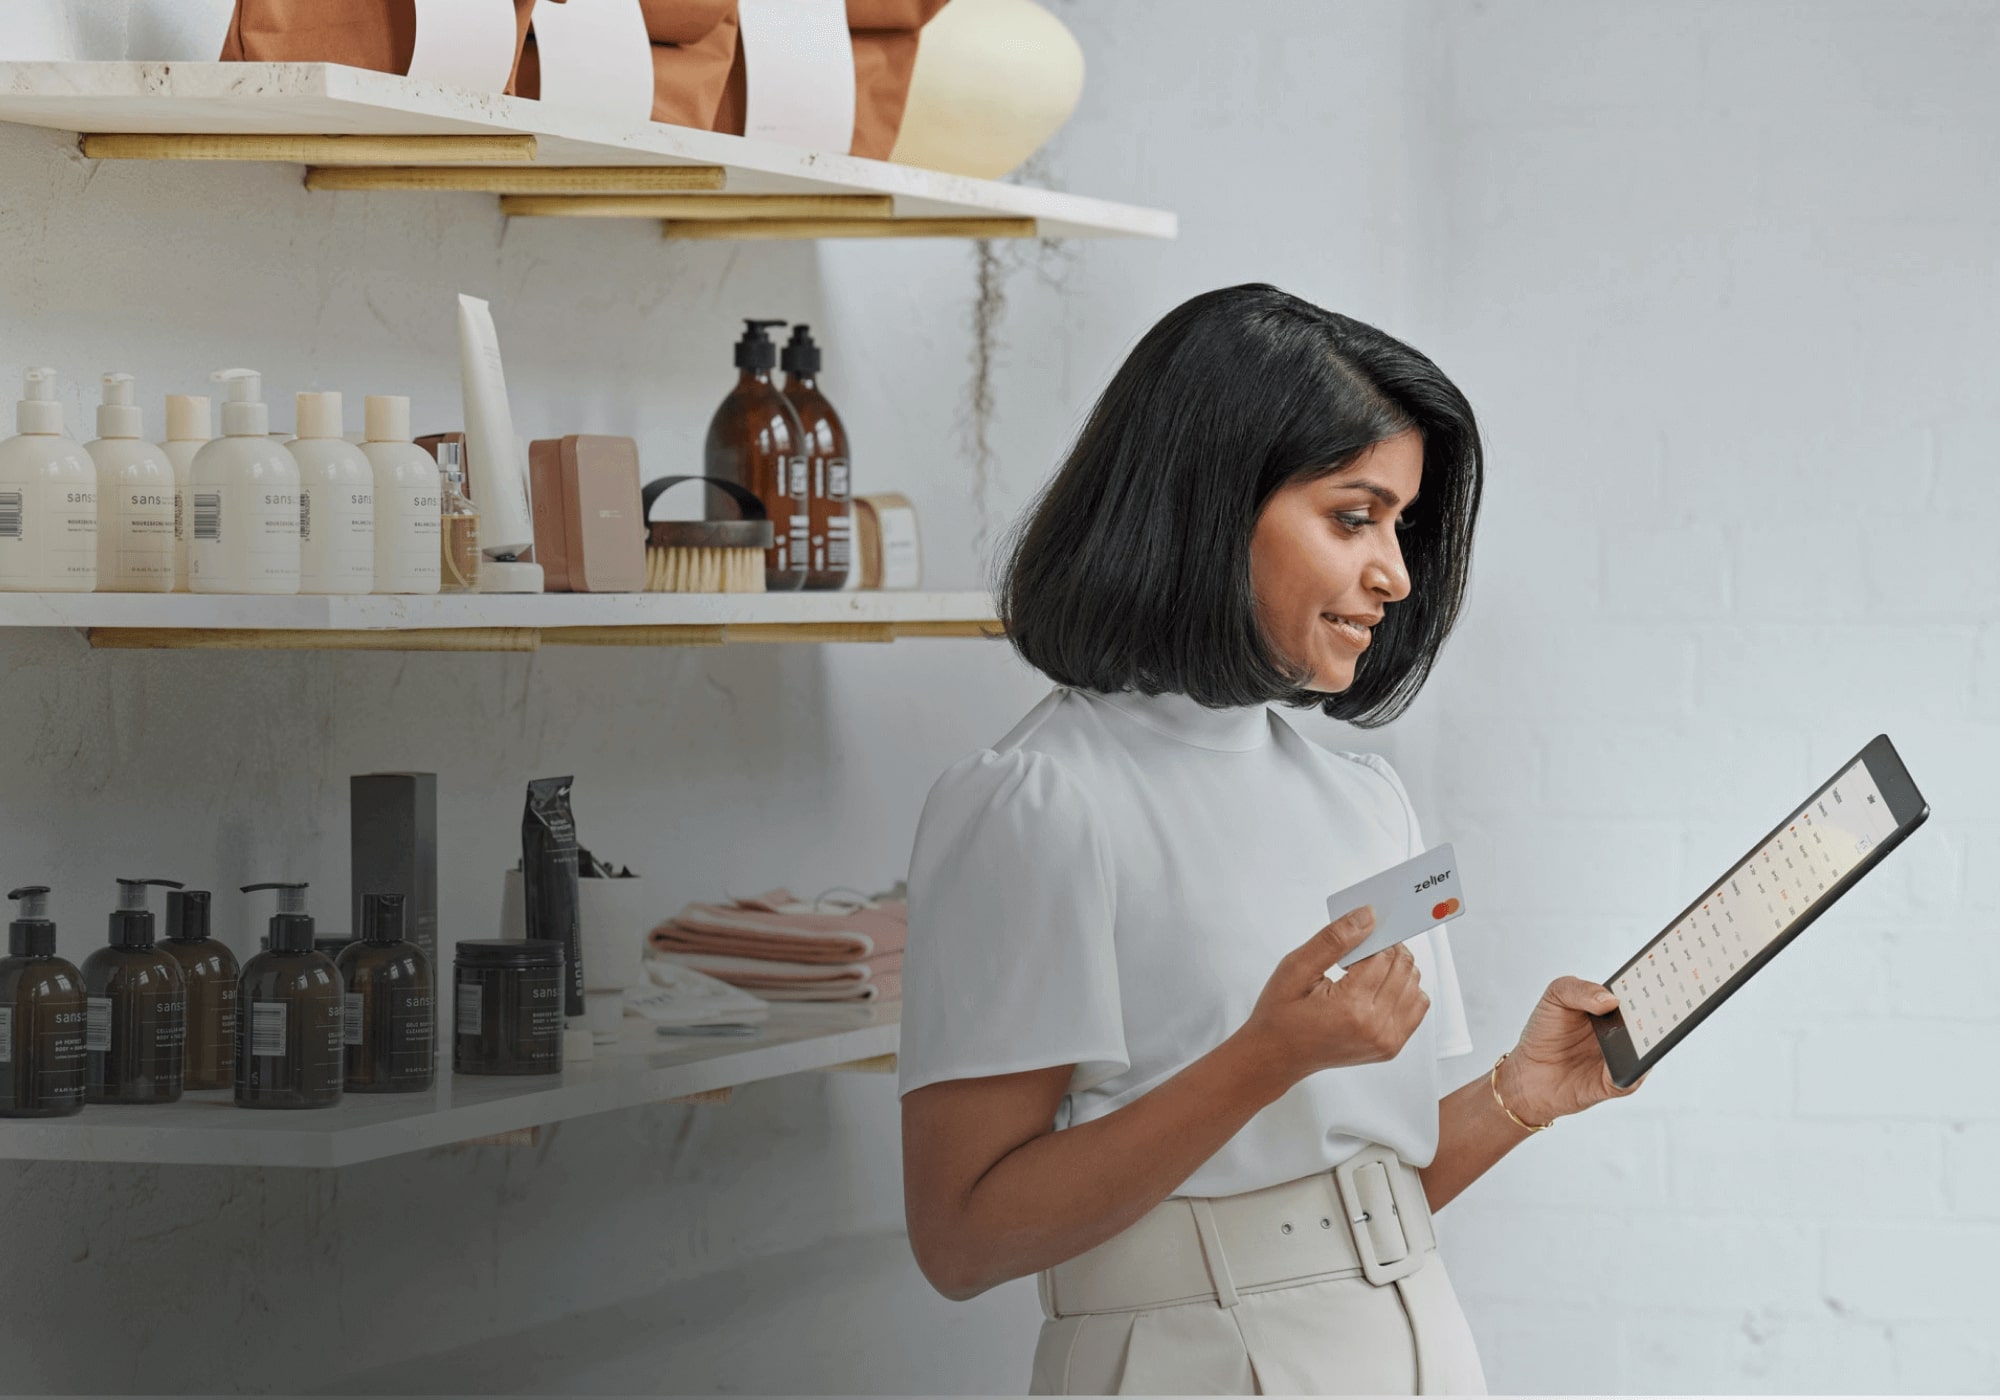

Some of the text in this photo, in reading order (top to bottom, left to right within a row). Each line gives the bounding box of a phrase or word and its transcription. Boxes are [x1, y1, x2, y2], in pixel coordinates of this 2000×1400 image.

[67, 493, 91, 503] sans
[131, 495, 161, 505] sans
[265, 494, 292, 505] sans
[351, 494, 372, 505] sans
[414, 496, 437, 507] sans
[1414, 869, 1451, 894] zeller
[575, 959, 583, 997] sans
[532, 988, 557, 998] sans
[156, 1002, 181, 1013] sans
[406, 997, 430, 1007] sans
[55, 1012, 81, 1024] sans
